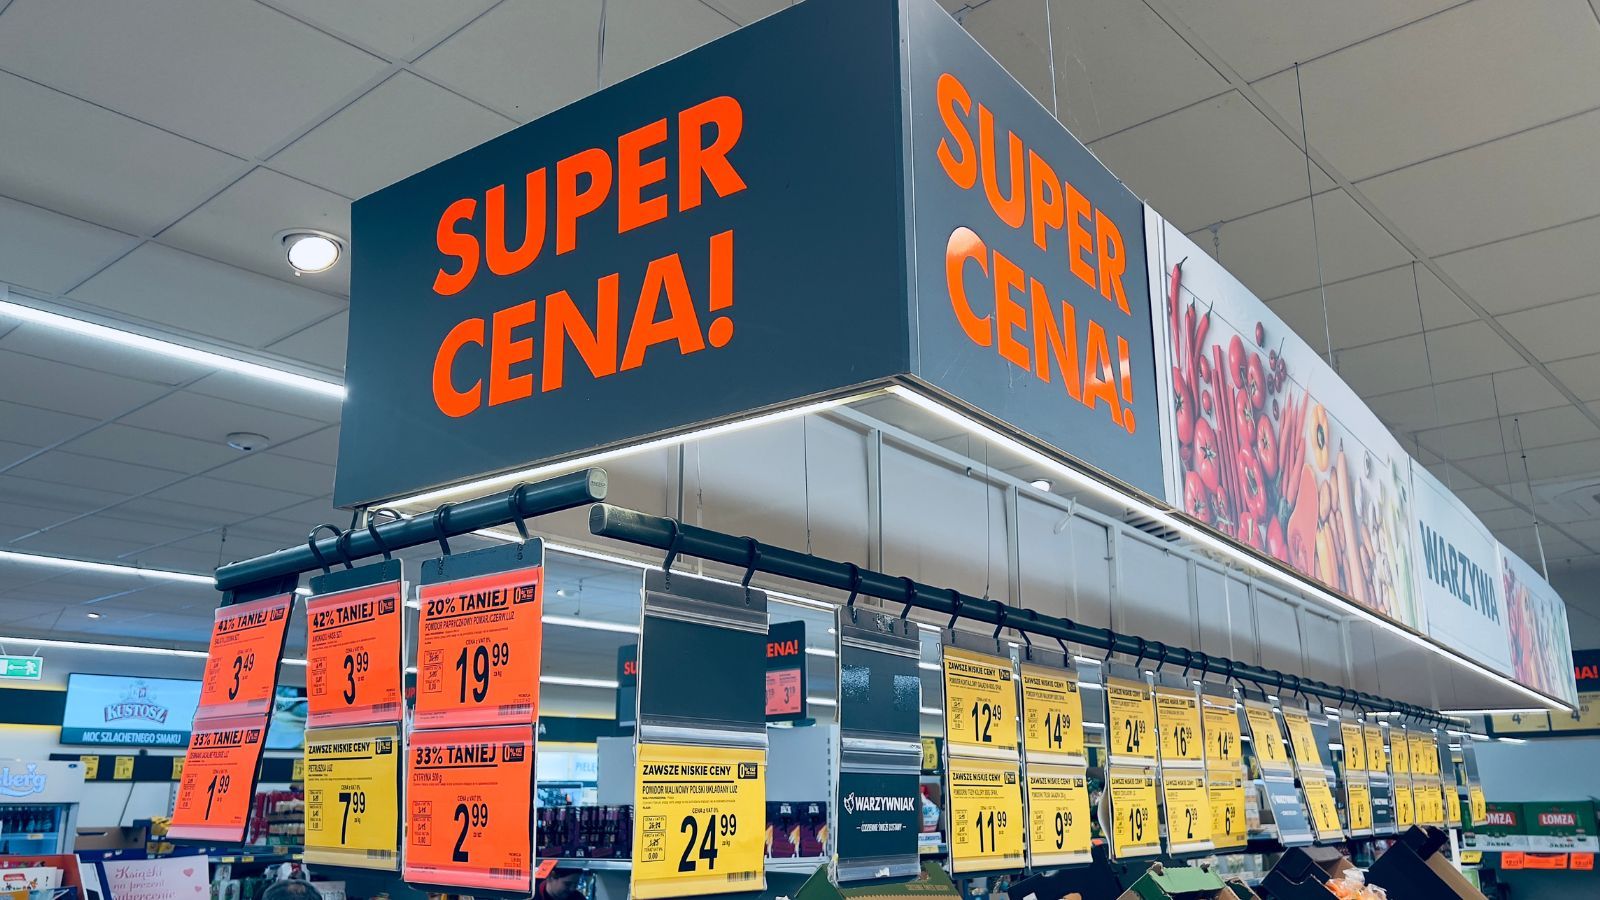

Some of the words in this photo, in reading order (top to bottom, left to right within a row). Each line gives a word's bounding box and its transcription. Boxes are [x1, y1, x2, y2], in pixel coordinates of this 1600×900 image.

[433, 96, 747, 295] SUPER
[937, 72, 1131, 316] SUPER
[433, 229, 734, 418] CENA!
[945, 226, 1136, 434] CENA!
[1419, 520, 1500, 626] WARZYWA
[313, 610, 335, 628] 42%
[336, 602, 374, 622] TANIEJ
[427, 597, 456, 616] 20%
[459, 588, 508, 611] TANIEJ
[237, 609, 267, 628] TANIEJ
[766, 639, 798, 657] ENA!
[229, 656, 242, 700] 3
[243, 653, 255, 671] 49
[344, 654, 355, 704] 3
[356, 651, 369, 672] 99
[456, 645, 489, 703] 19
[492, 642, 509, 667] 99
[948, 661, 968, 672] ZAWSZE
[968, 664, 983, 674] NISKIE
[983, 667, 996, 676] CENY
[1024, 676, 1041, 685] ZAWSZE
[1041, 679, 1053, 687] NISKIE
[1053, 680, 1064, 688] CENY
[105, 703, 168, 723] KUSTOSZ
[972, 701, 992, 742] 12
[992, 704, 1001, 720] 49
[82, 731, 100, 742] MOC
[101, 731, 155, 743] SZLACHETNEGO
[156, 733, 181, 744] SMAKU
[193, 733, 211, 746] 33%
[213, 730, 244, 745] TANIEJ
[1045, 712, 1062, 749] 14
[1062, 714, 1070, 728] 99
[1125, 719, 1139, 753] 24
[1139, 720, 1145, 733] 99
[1174, 726, 1186, 756] 16
[1186, 727, 1192, 739] 99
[308, 743, 332, 755] ZAWSZE
[333, 743, 353, 753] NISKIE
[353, 741, 370, 752] CENY
[416, 746, 443, 764] 33%
[447, 743, 497, 764] TANIEJ
[1217, 731, 1228, 760] 14
[0, 765, 47, 793] berg
[642, 764, 679, 776] ZAWSZE
[681, 765, 708, 776] NISKIE
[709, 766, 731, 776] CENY
[952, 772, 972, 781] ZAWSZE
[973, 773, 988, 781] NISKIE
[988, 773, 1000, 781] CENY
[1030, 777, 1047, 785] ZAWSZE
[205, 775, 217, 820] 1
[218, 775, 230, 794] 99
[642, 785, 665, 794] POMIDOR
[664, 785, 689, 794] MALINOWY
[689, 785, 706, 794] POLSKI
[855, 796, 915, 812] WARZYWNIAK
[339, 792, 351, 844] 7
[352, 791, 366, 814] 99
[976, 811, 995, 852] 11
[997, 811, 1007, 827] 99
[1055, 812, 1064, 849] 9
[1063, 812, 1072, 826] 99
[1129, 808, 1142, 841] 19
[1141, 808, 1148, 821] 99
[1185, 808, 1193, 838] 2
[1486, 813, 1513, 825] OMŻA
[1542, 814, 1575, 825] ŁOMŻA
[452, 803, 469, 862] 2
[472, 803, 488, 827] 99
[678, 814, 718, 872] 24
[720, 814, 736, 836] 99
